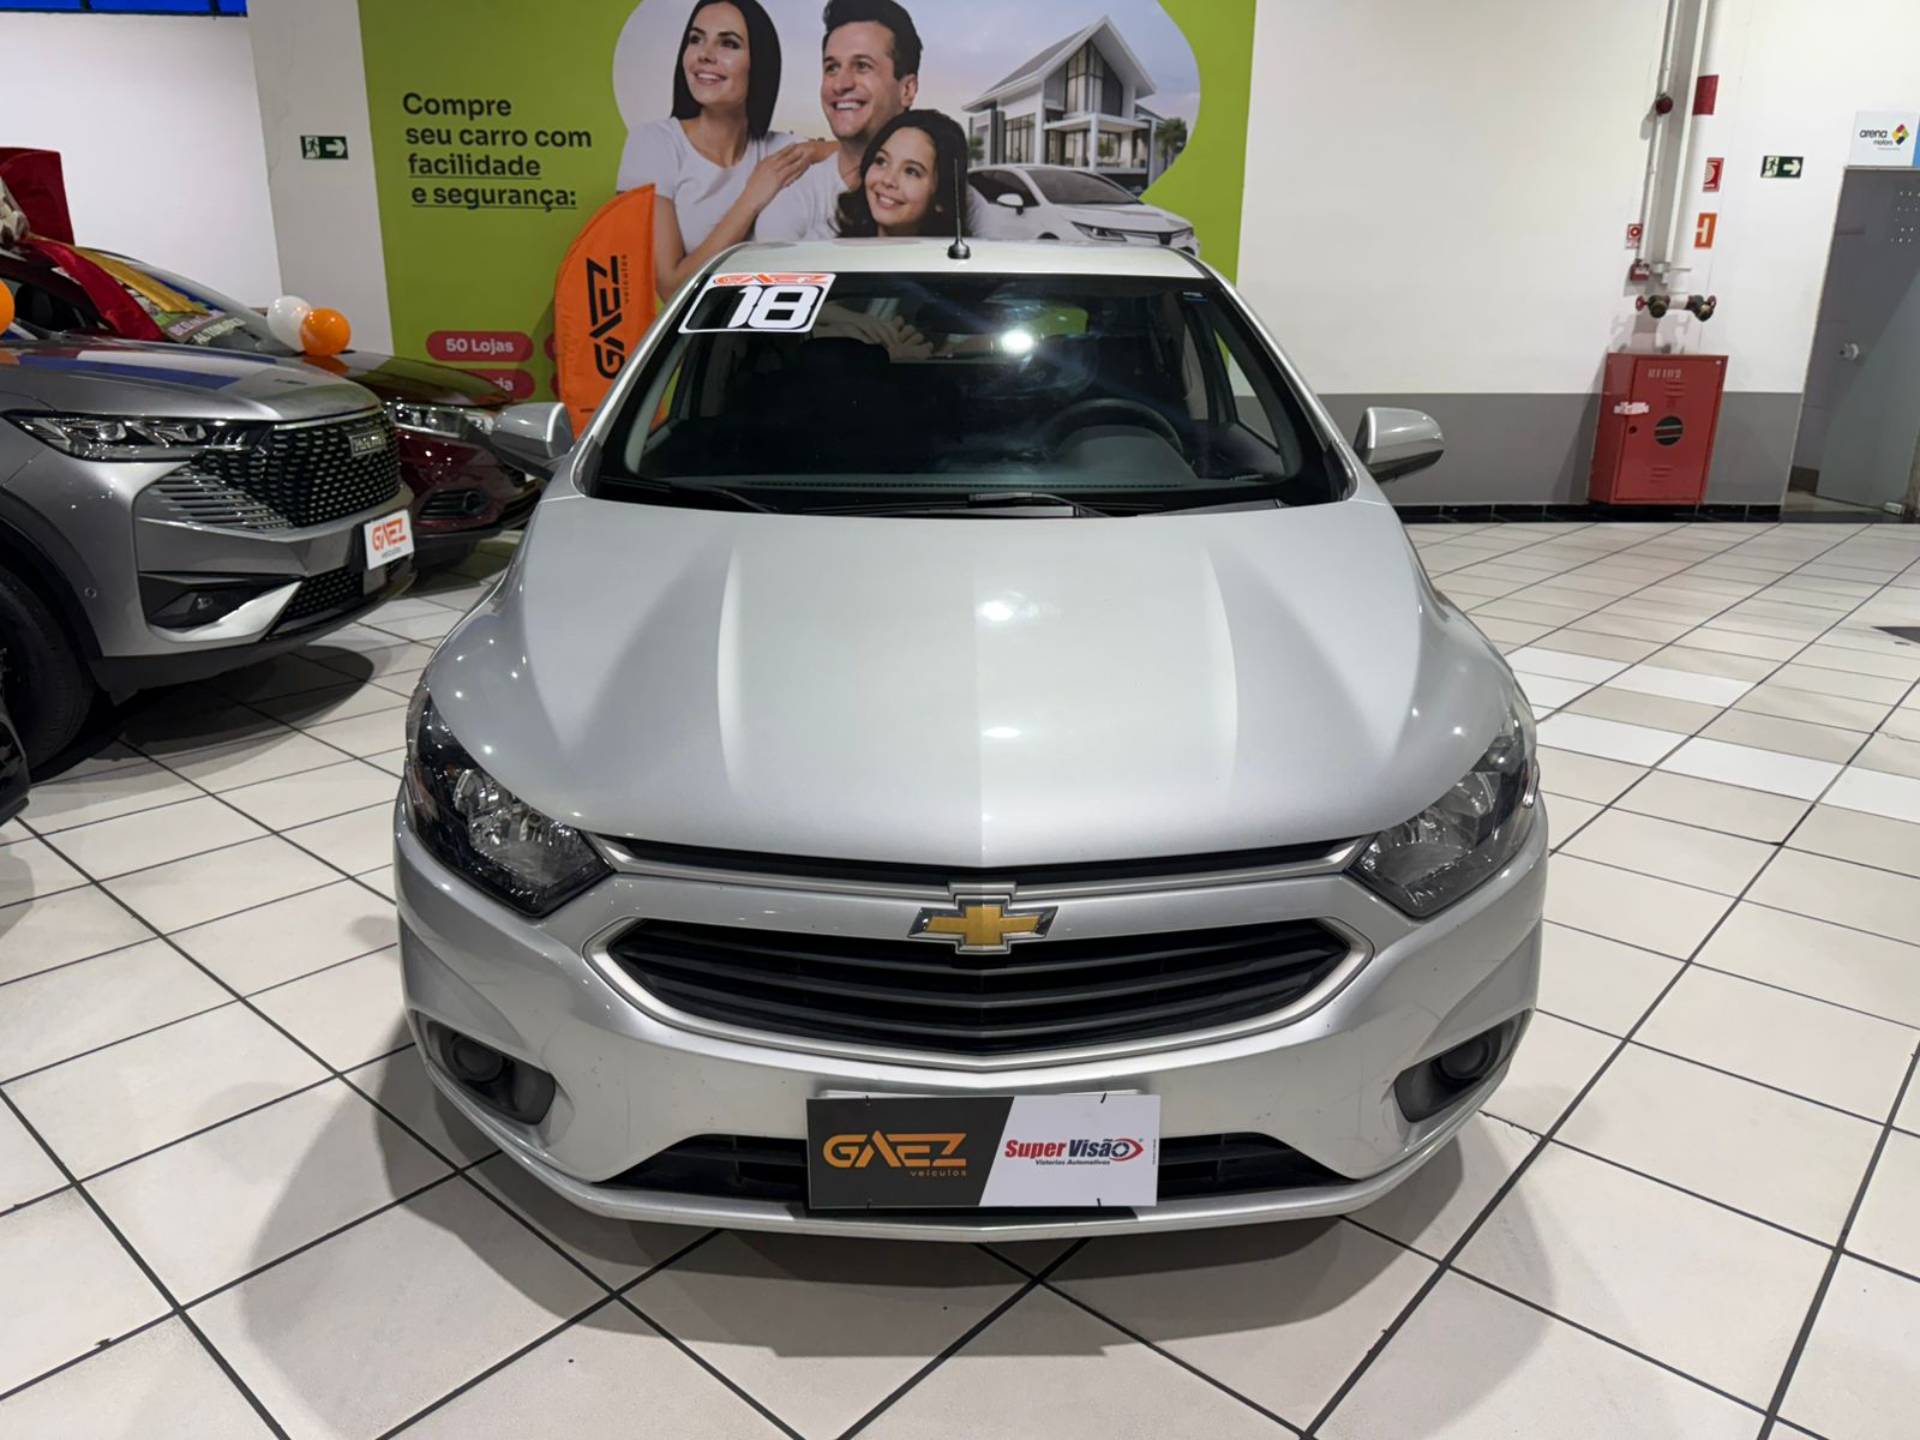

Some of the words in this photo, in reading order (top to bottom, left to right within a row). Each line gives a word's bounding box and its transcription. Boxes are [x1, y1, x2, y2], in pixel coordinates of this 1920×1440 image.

[403, 92, 512, 121] Compre
[405, 127, 452, 145] seu
[459, 128, 528, 146] carro
[534, 129, 592, 147] com
[1859, 129, 1888, 139] arena
[408, 153, 541, 176] facilidade
[412, 186, 427, 204] e
[433, 187, 577, 212] segurança:
[586, 255, 625, 379] GAEZ
[727, 285, 820, 329] 18
[446, 338, 466, 351] 50
[471, 338, 514, 355] Lojas
[823, 1130, 967, 1168] GAEZ
[1005, 1139, 1067, 1159] Super
[1068, 1138, 1130, 1158] Visão
